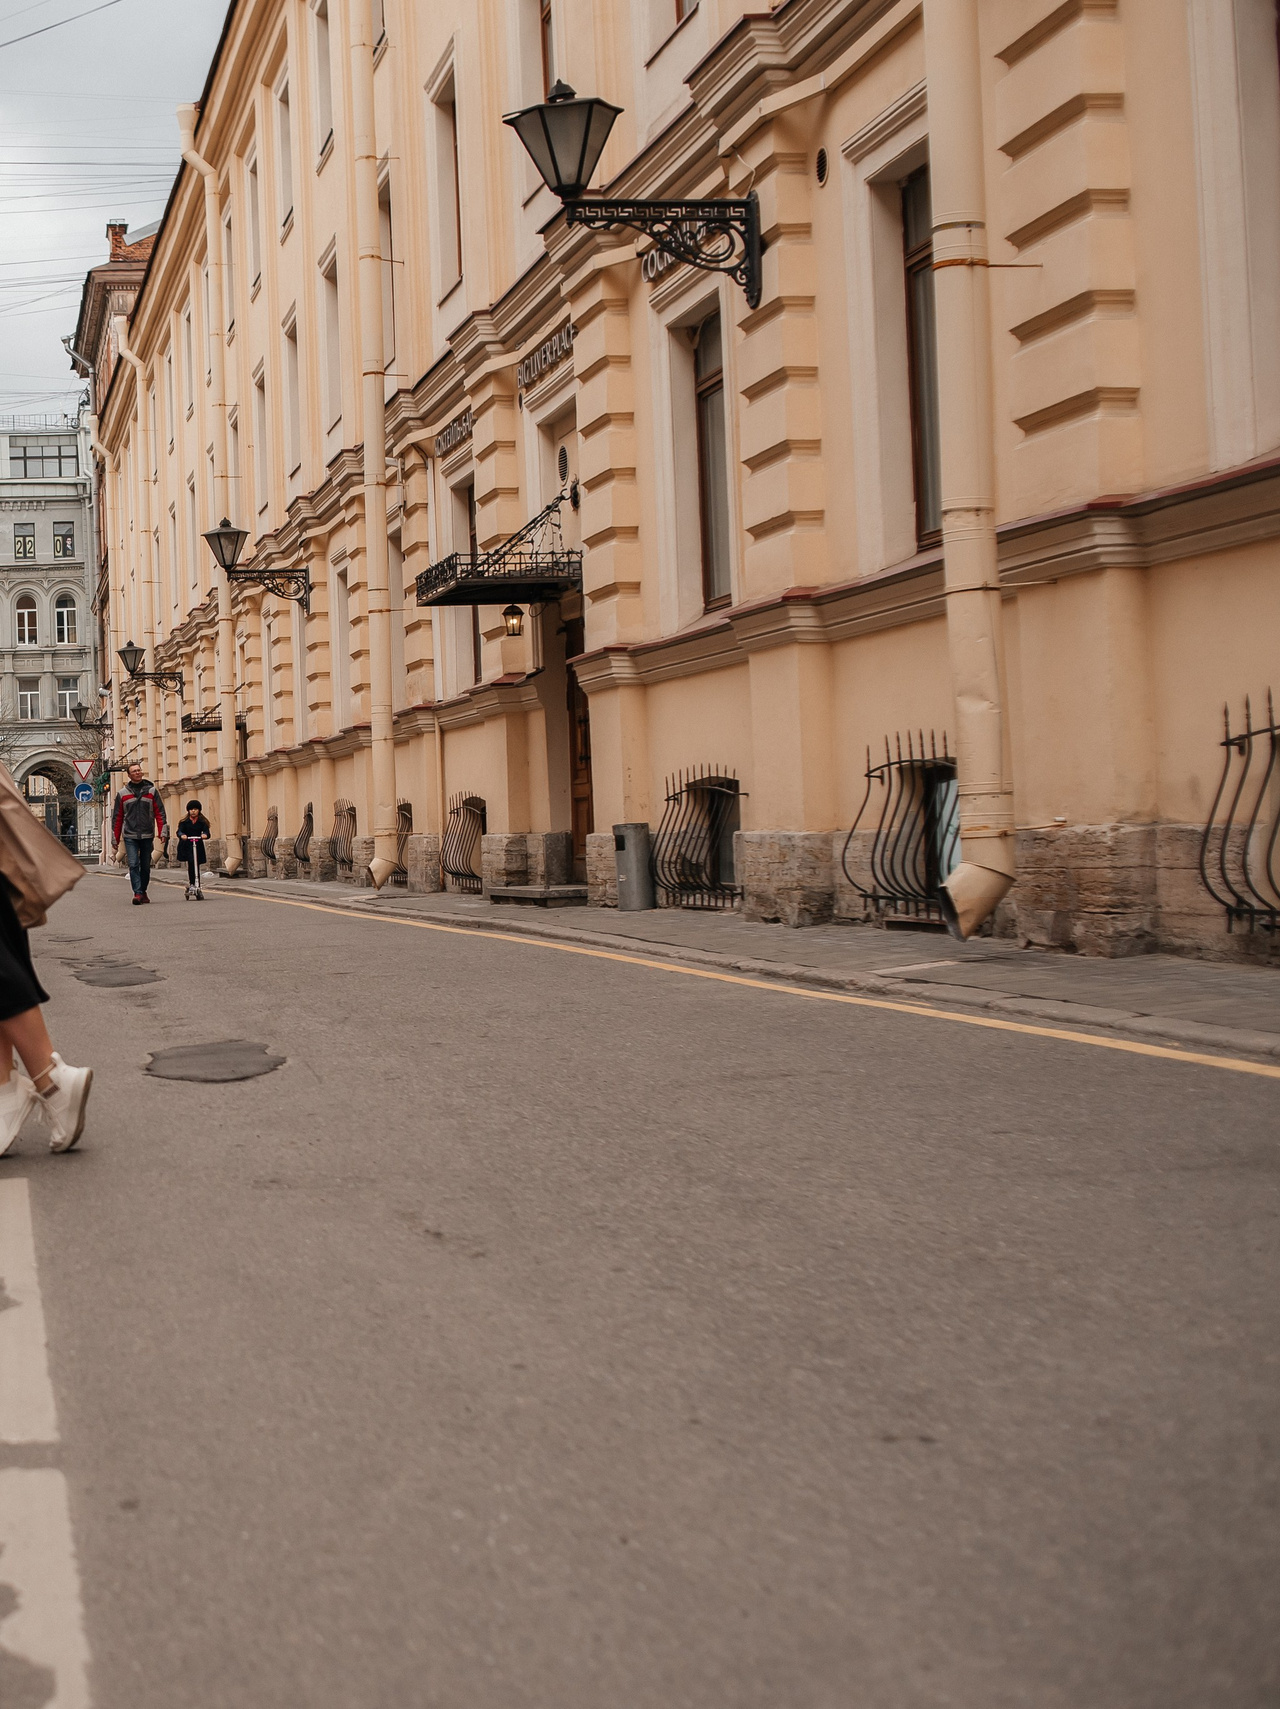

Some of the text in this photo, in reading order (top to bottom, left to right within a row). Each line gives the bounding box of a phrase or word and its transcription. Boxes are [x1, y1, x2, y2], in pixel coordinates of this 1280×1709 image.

[517, 358, 530, 389] BIG
[530, 340, 552, 378] LIVER
[16, 539, 34, 555] 22
